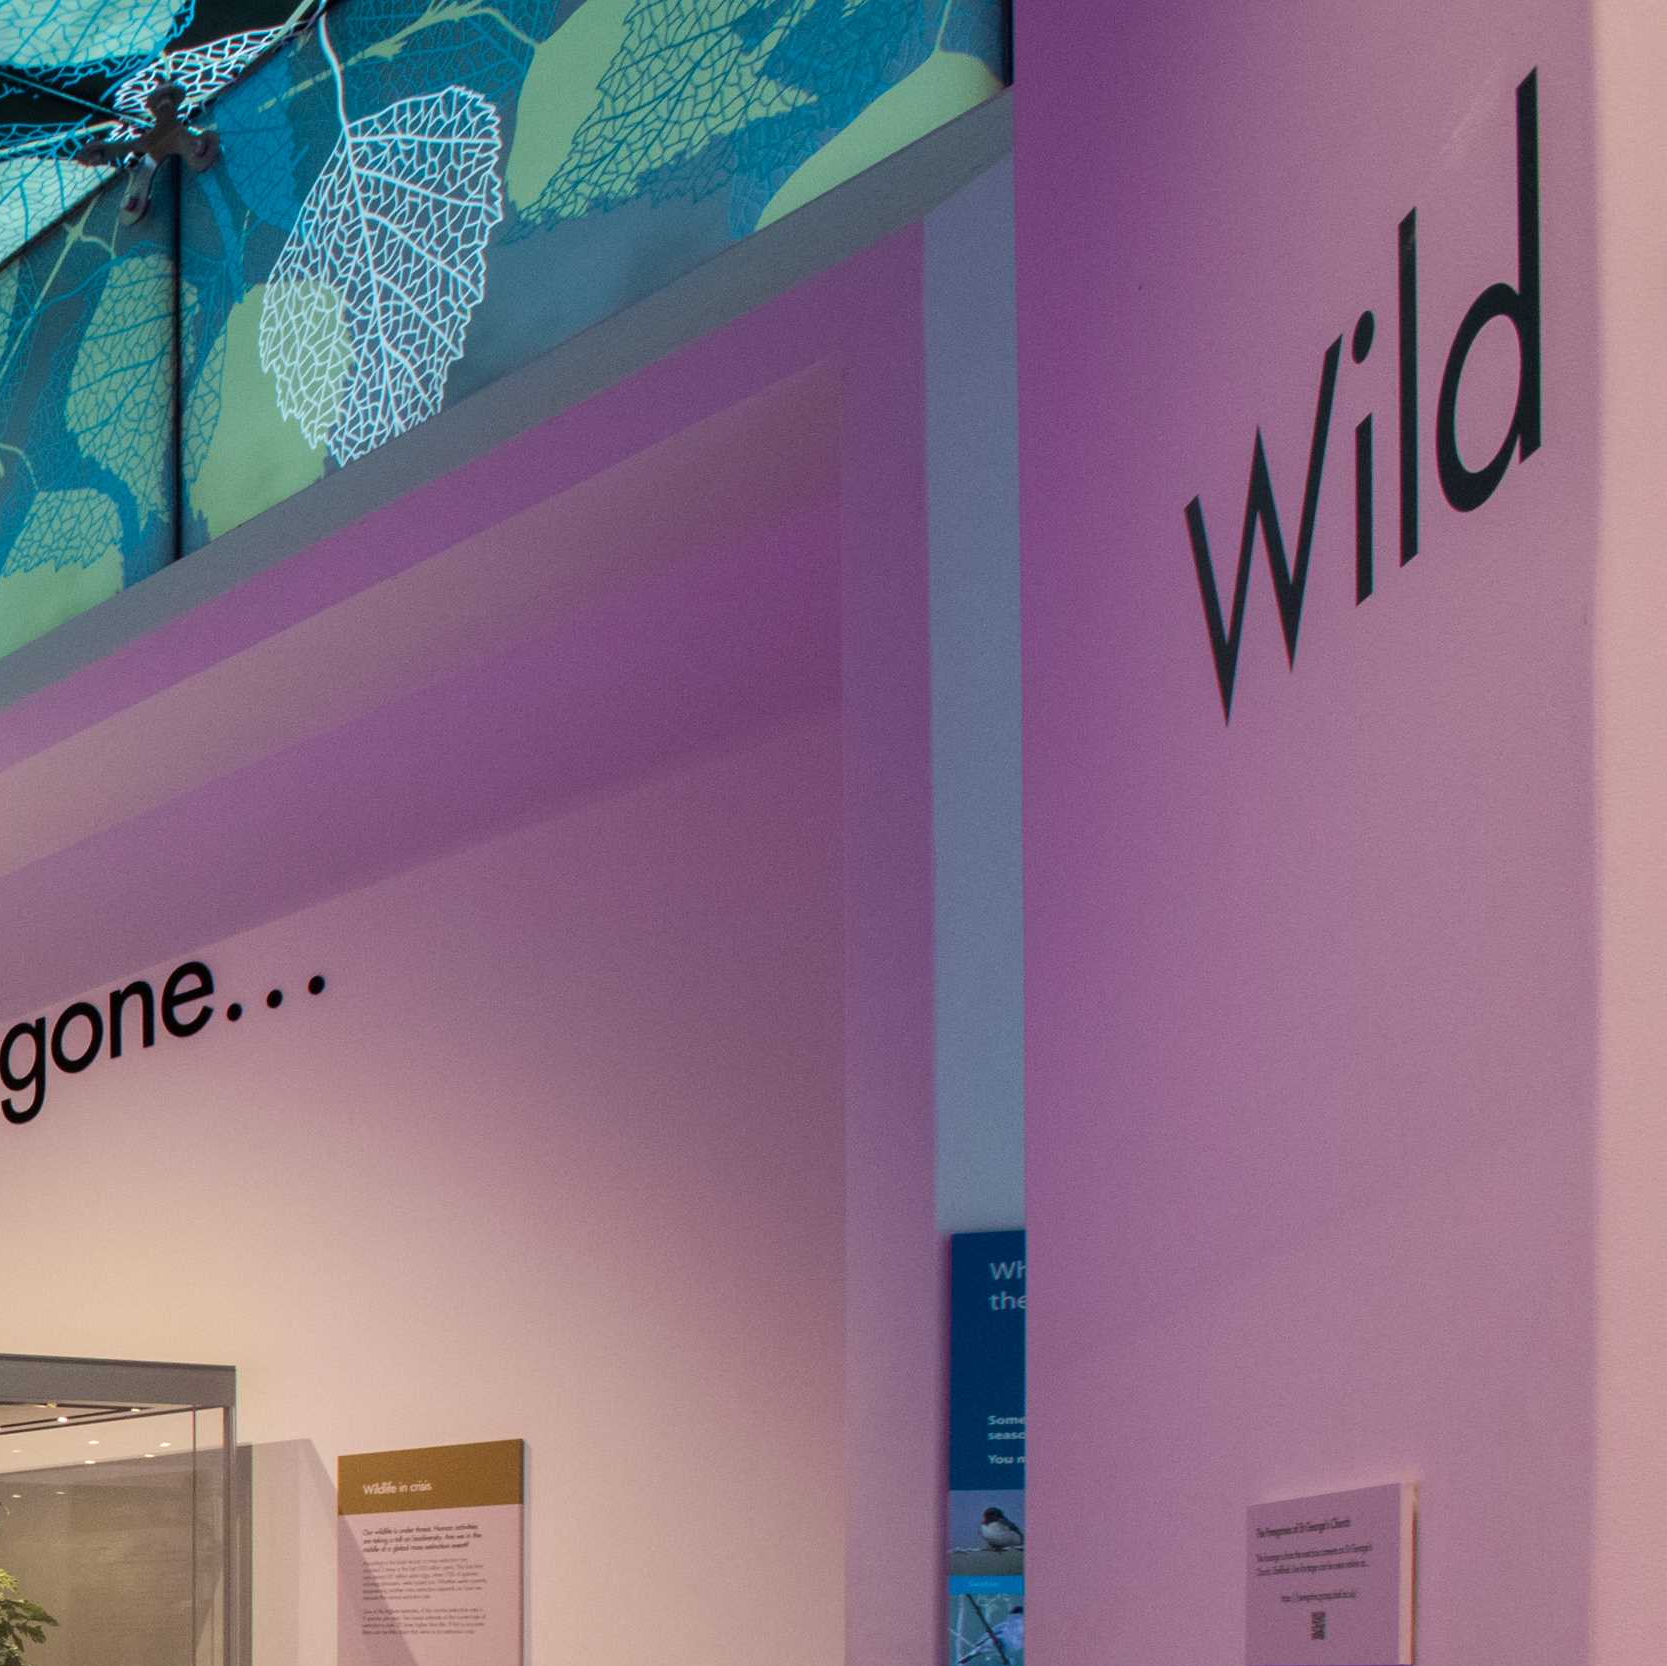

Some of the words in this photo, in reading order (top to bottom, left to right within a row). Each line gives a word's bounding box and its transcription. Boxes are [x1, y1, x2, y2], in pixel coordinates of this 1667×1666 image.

[1184, 66, 1541, 727] Wild
[987, 1455, 1014, 1464] You
[363, 1481, 396, 1494] Wildlife
[399, 1482, 407, 1492] in
[410, 1480, 432, 1492] crisis
